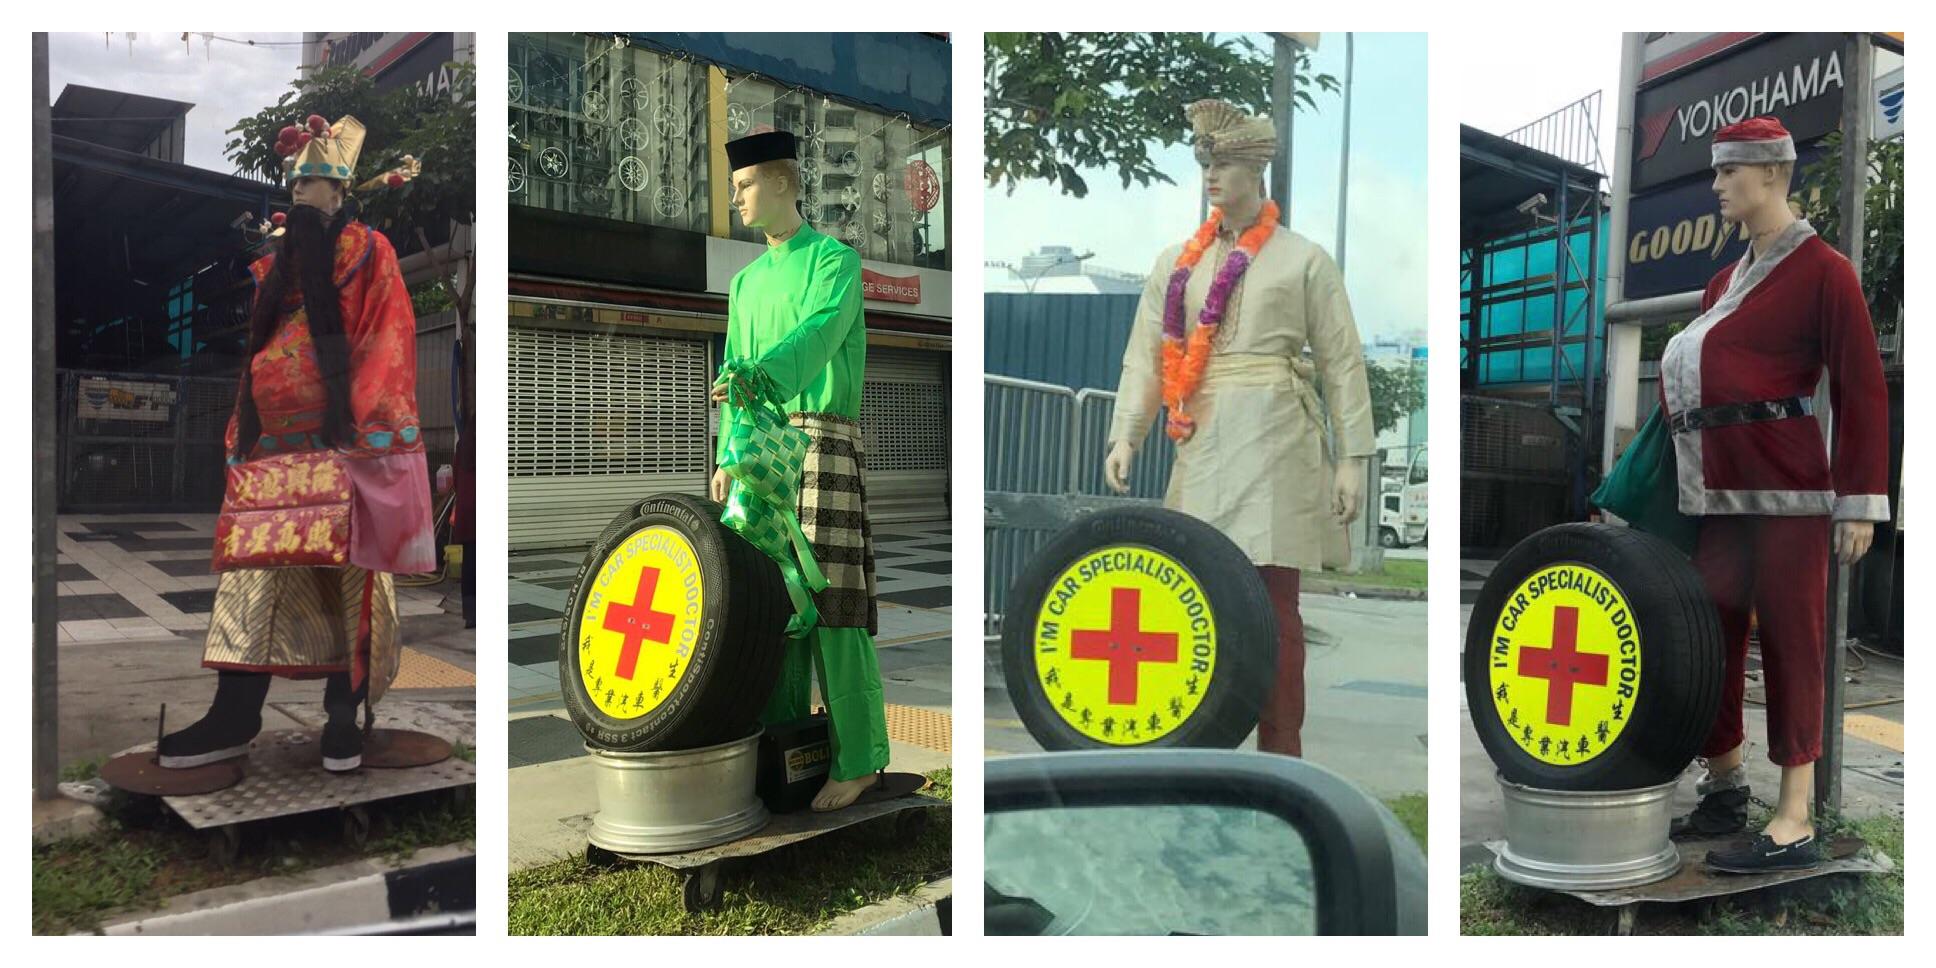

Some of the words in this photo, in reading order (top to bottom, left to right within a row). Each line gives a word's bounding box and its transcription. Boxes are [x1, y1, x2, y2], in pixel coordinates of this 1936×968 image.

[1677, 50, 1844, 142] YOKOHAMA
[876, 283, 919, 297] SERVICES
[640, 501, 695, 525] Continental
[1079, 551, 1187, 591] SPECIALIST
[586, 591, 603, 621] I'M
[600, 552, 625, 588] CAR
[625, 533, 693, 574] SPECIALIST
[676, 571, 699, 659] DOCTOR
[1049, 577, 1081, 616] CAR
[1040, 621, 1059, 654] I'M
[1178, 587, 1211, 674] DOCTOR
[1494, 636, 1510, 668] I'M
[1502, 592, 1530, 632] CAR
[1528, 569, 1618, 612] SPECIALIST
[1611, 607, 1636, 699] DOCTOR
